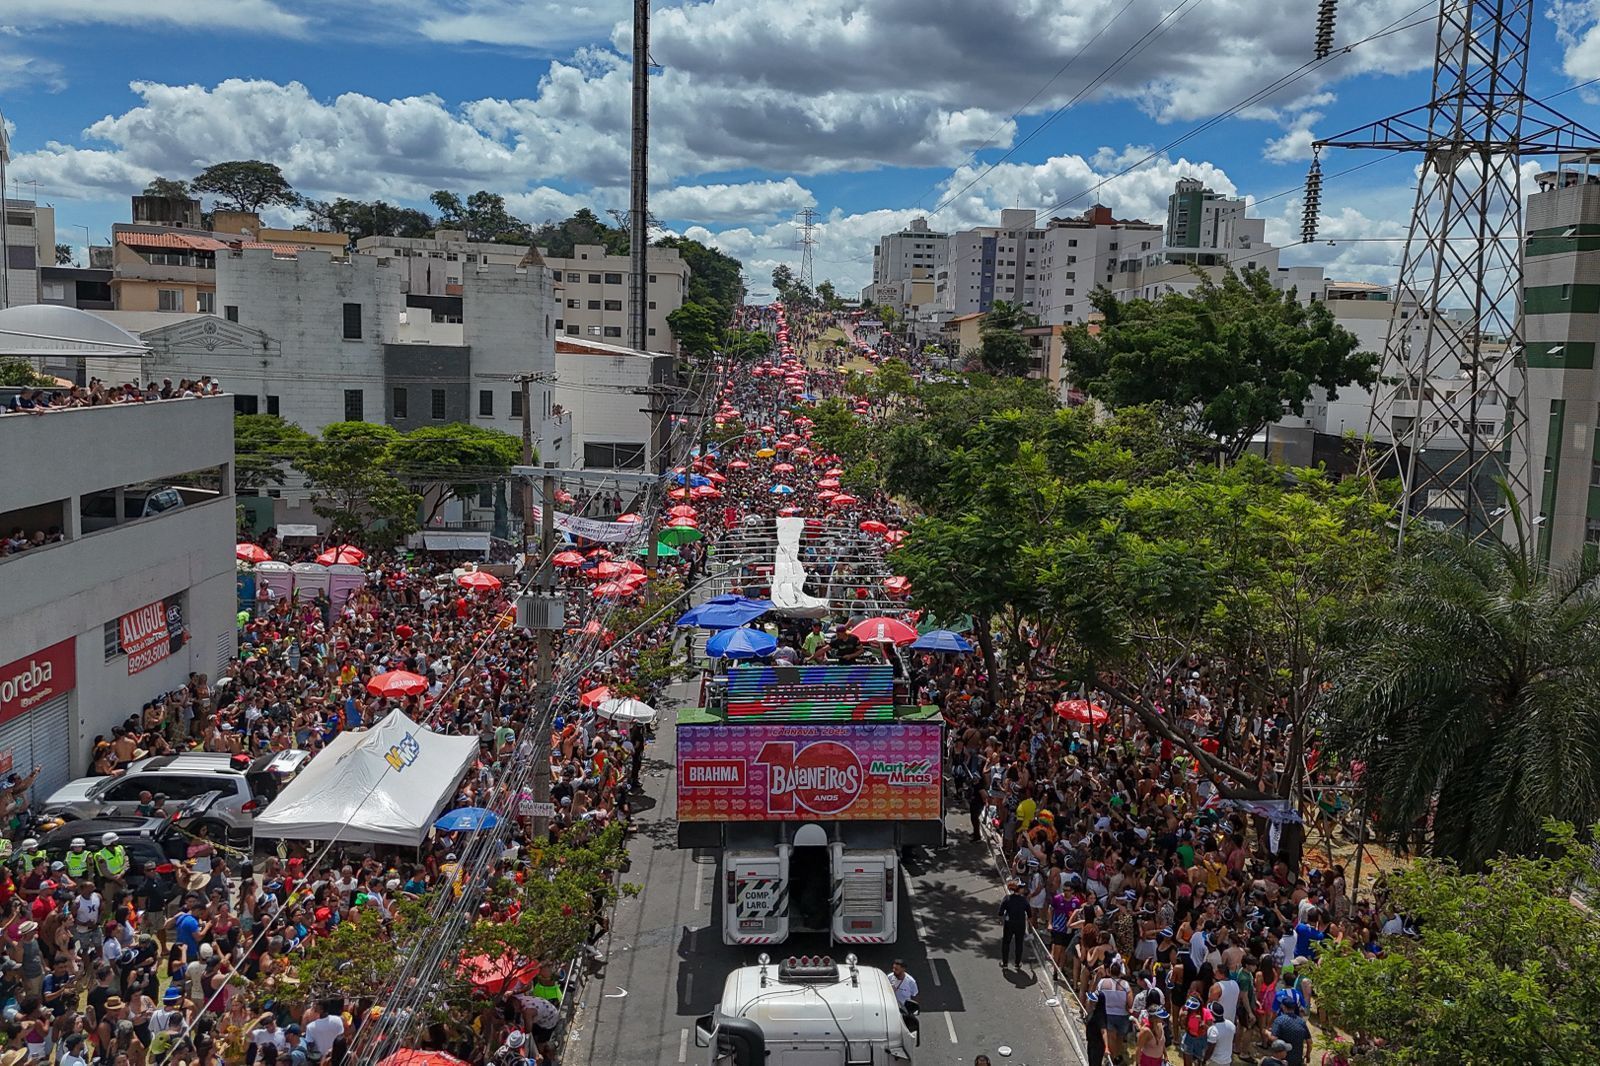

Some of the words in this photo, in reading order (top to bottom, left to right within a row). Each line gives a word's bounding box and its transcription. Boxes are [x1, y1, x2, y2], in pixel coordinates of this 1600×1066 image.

[123, 602, 165, 644] ALUGUE
[871, 762, 904, 773] Mart
[689, 766, 739, 782] BRAHMA
[890, 772, 931, 783] Minas
[814, 794, 839, 802] ANOS
[745, 891, 771, 900] COMP.
[746, 901, 769, 909] LARG.
